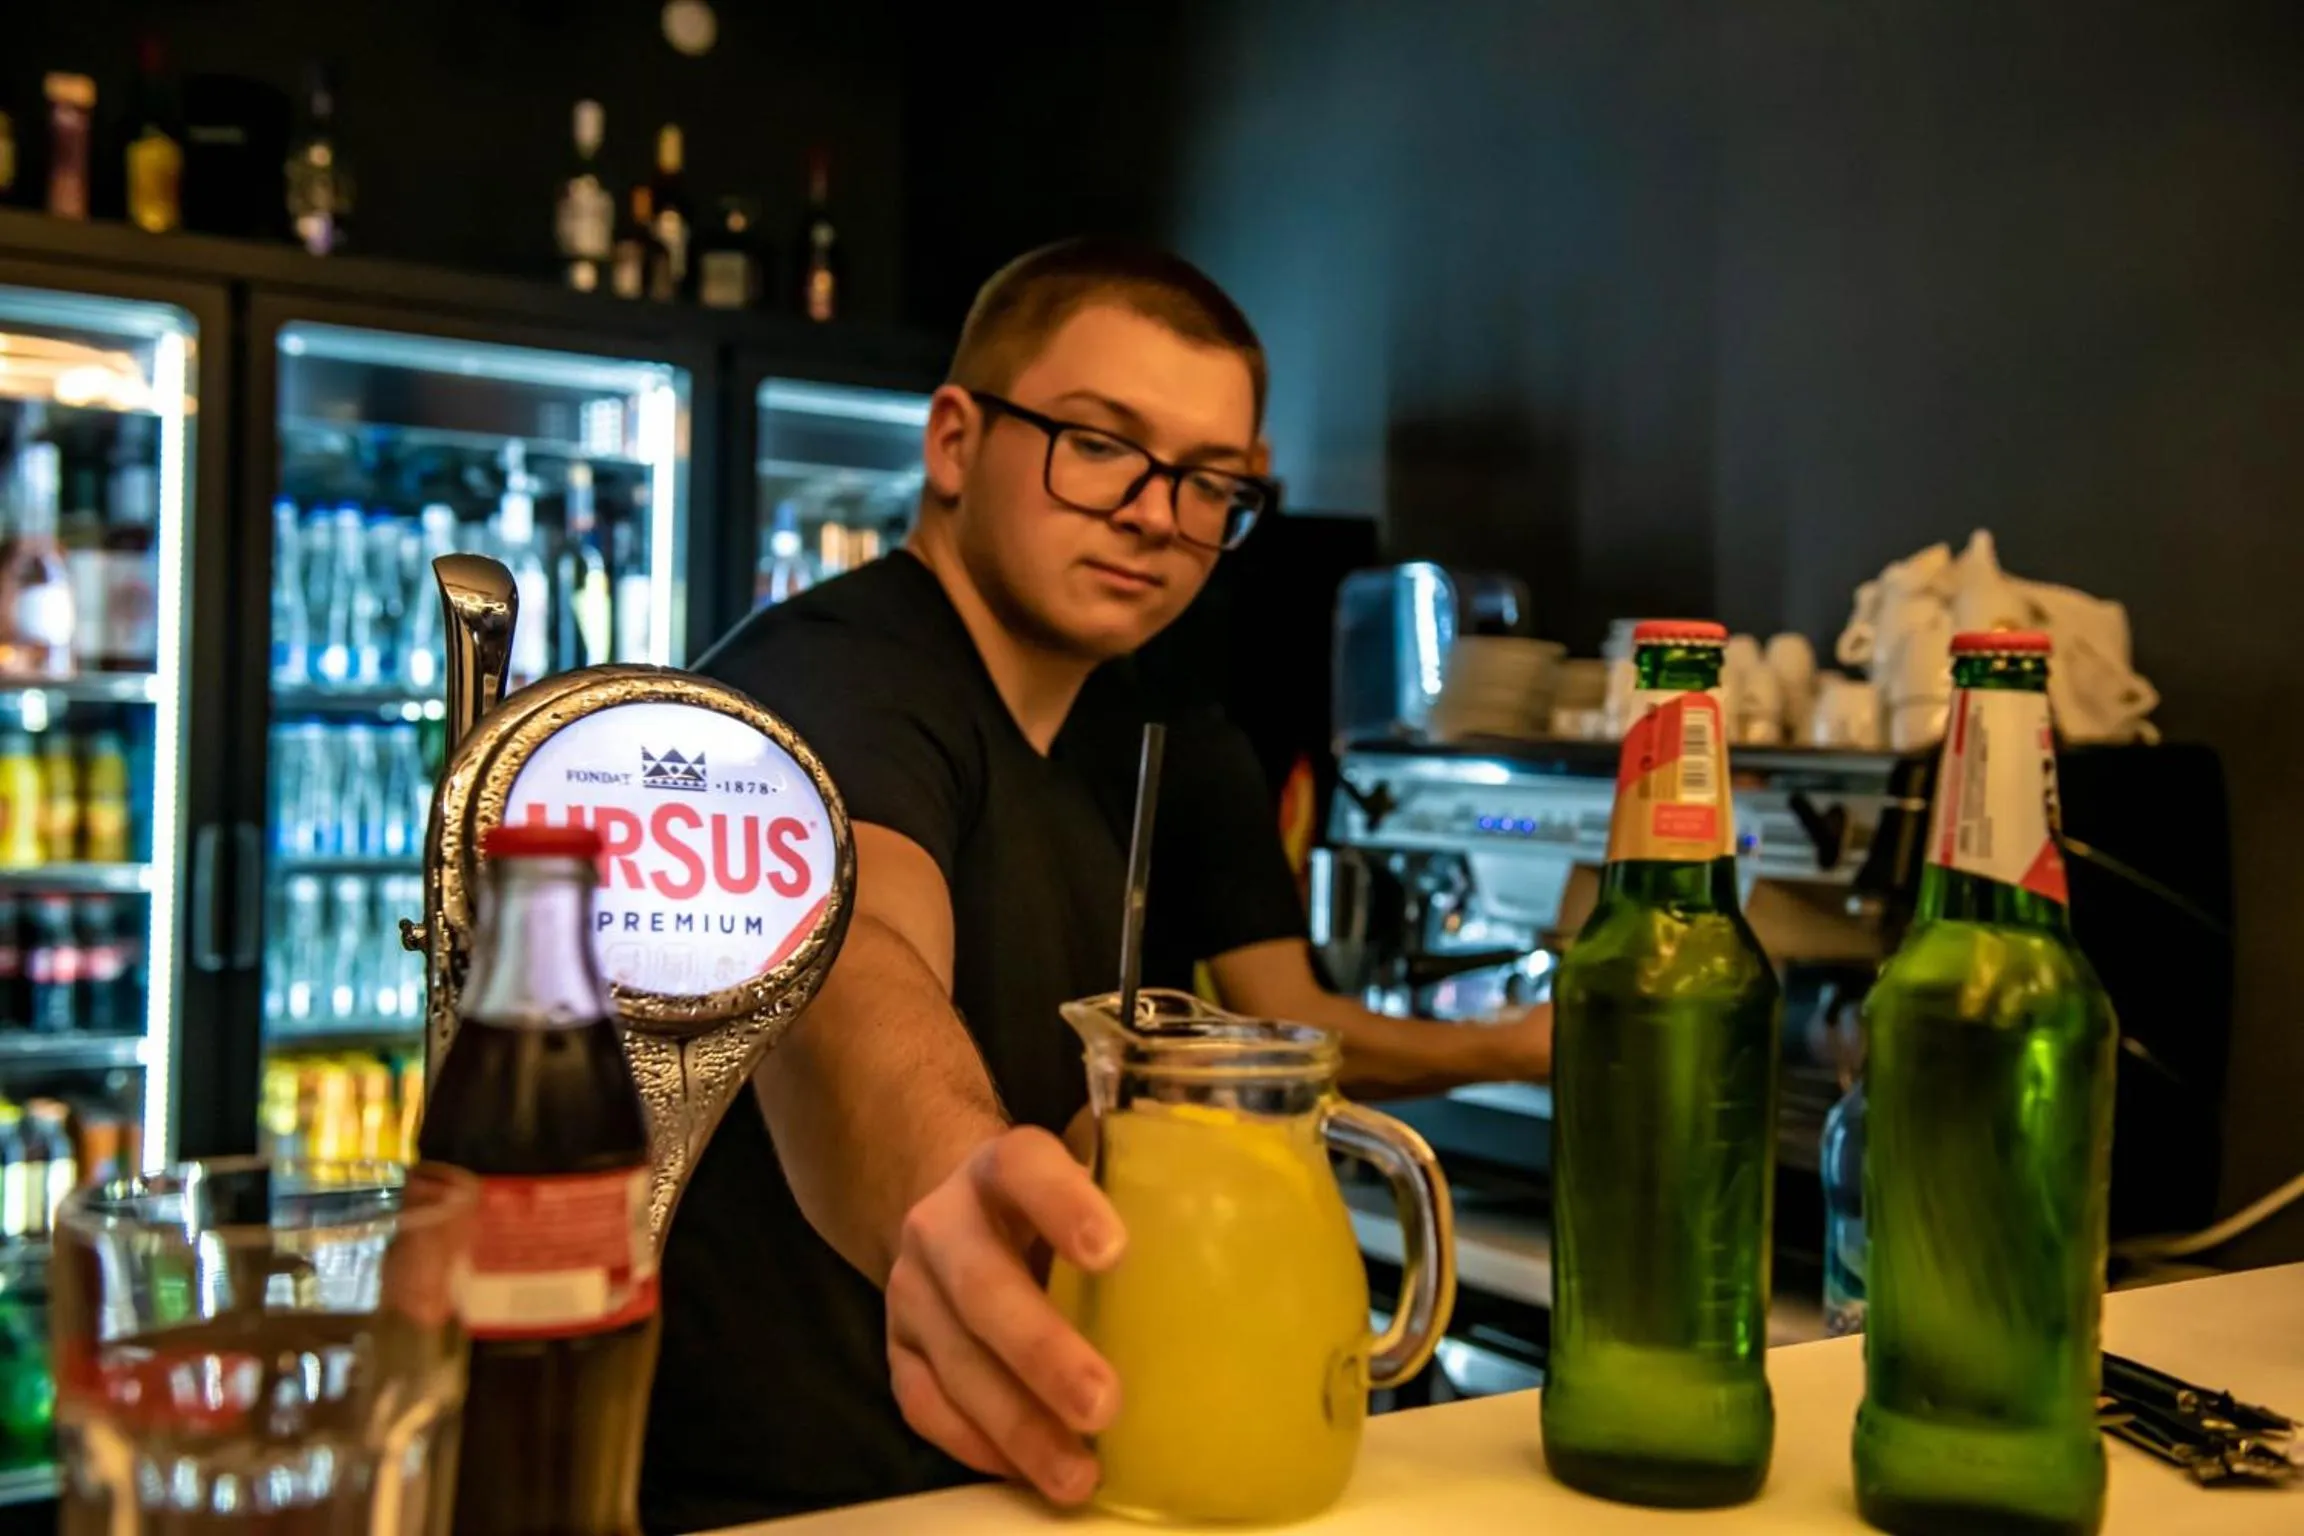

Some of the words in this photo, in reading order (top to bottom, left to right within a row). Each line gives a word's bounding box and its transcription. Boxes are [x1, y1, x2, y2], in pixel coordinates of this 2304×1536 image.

[566, 769, 632, 786] FONDAT
[525, 802, 812, 900] RSUS
[596, 911, 763, 936] PREMIUM
